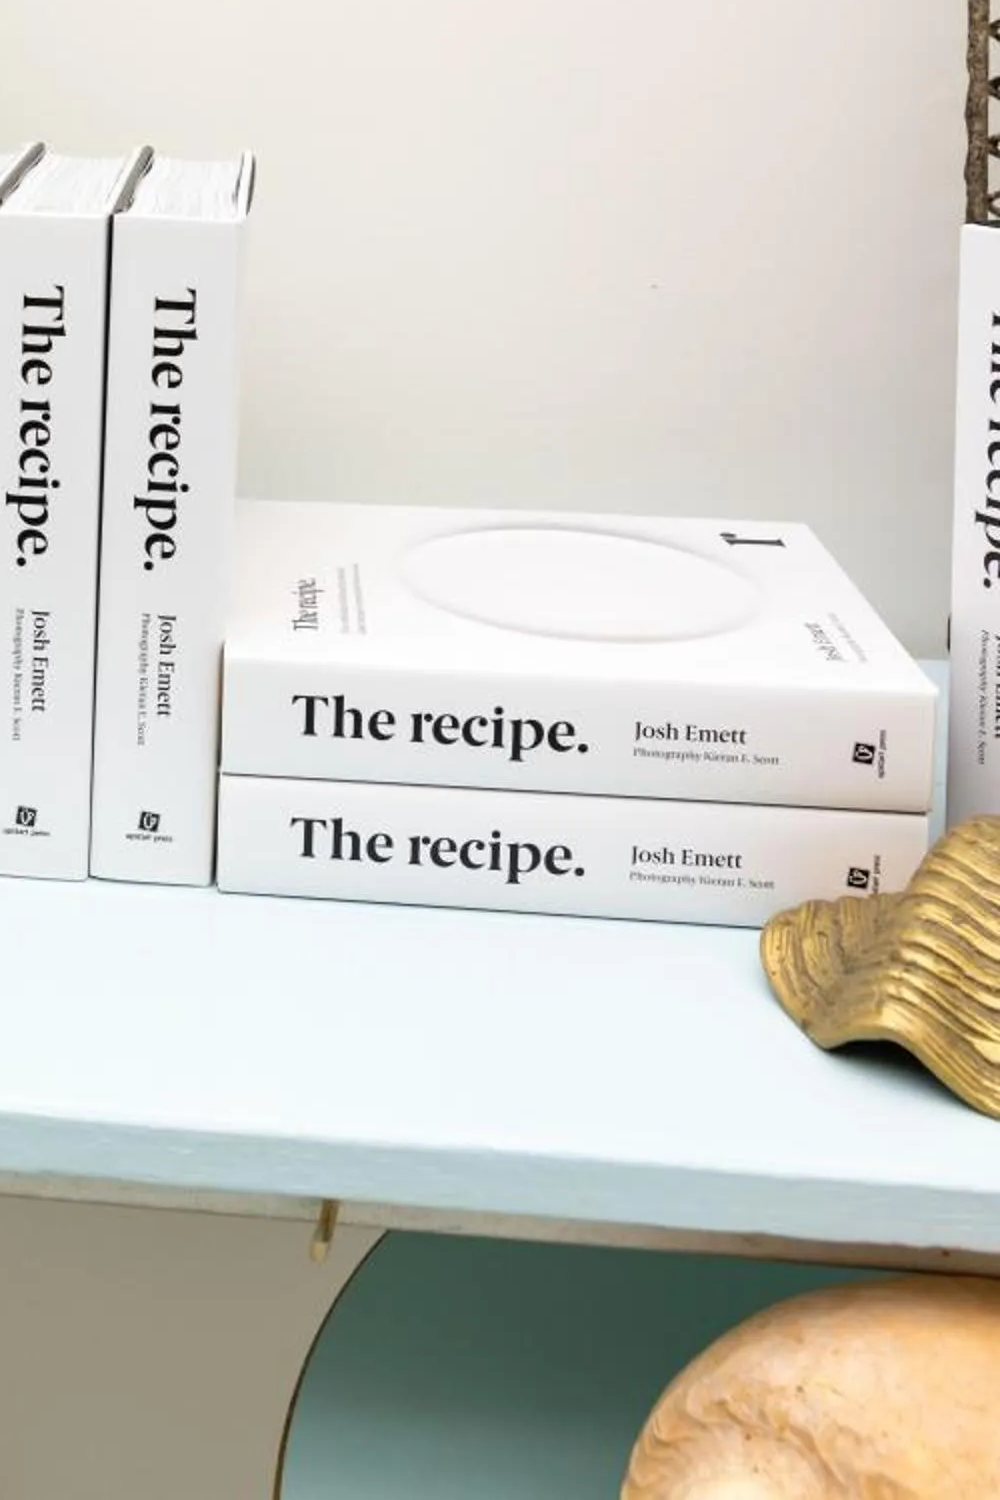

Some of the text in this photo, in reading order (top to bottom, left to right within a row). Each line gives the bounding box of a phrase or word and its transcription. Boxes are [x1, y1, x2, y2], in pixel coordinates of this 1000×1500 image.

[5, 285, 66, 567] The recipe.
[133, 288, 198, 571] The recipe.
[12, 608, 25, 670] Photography
[31, 610, 50, 712] Josh Emett
[156, 615, 176, 716] Josh Emett
[292, 694, 589, 762] The recipe.
[633, 747, 700, 762] Photography
[703, 751, 739, 763] Kieran
[753, 754, 779, 765] Scott
[635, 721, 748, 745] Josh Emett
[290, 817, 585, 885] The recipe.
[629, 871, 695, 886] Photography
[699, 875, 735, 887] Kieran
[632, 845, 742, 869] Josh Emett
